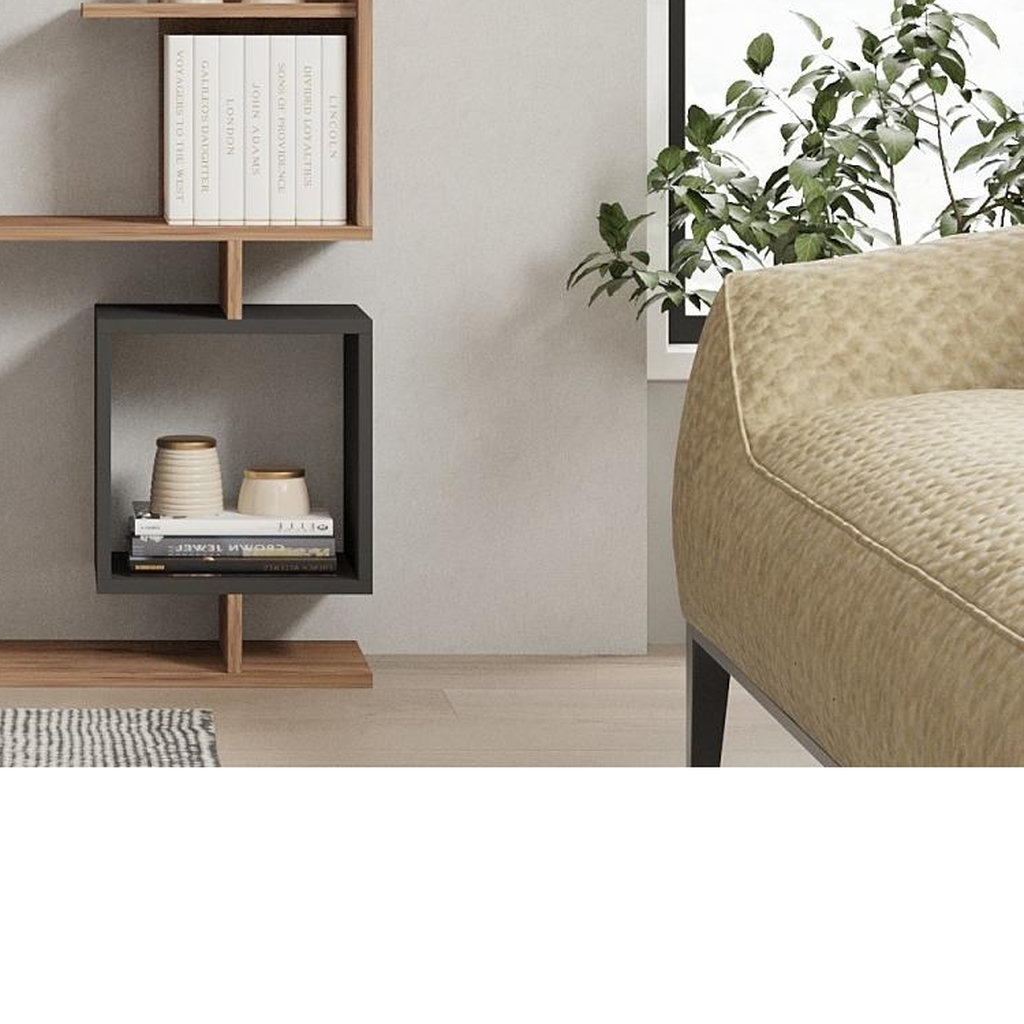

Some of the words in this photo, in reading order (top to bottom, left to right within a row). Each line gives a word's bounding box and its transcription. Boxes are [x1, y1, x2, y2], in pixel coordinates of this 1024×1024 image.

[176, 50, 185, 116] VOYAGERS
[252, 83, 263, 119] JOHN
[278, 63, 286, 95] SONS
[303, 65, 312, 115] DIVIDED
[176, 118, 185, 136] TO
[226, 98, 235, 155] LONDON
[278, 97, 286, 114] OF
[329, 95, 338, 159] LINCOLN
[176, 140, 185, 164] THE
[201, 126, 210, 193] DAUGHTER
[252, 125, 260, 176] ADAMS
[278, 117, 286, 193] PROVIDENCE
[303, 119, 312, 187] LOYALTIES
[176, 168, 185, 203] WEST
